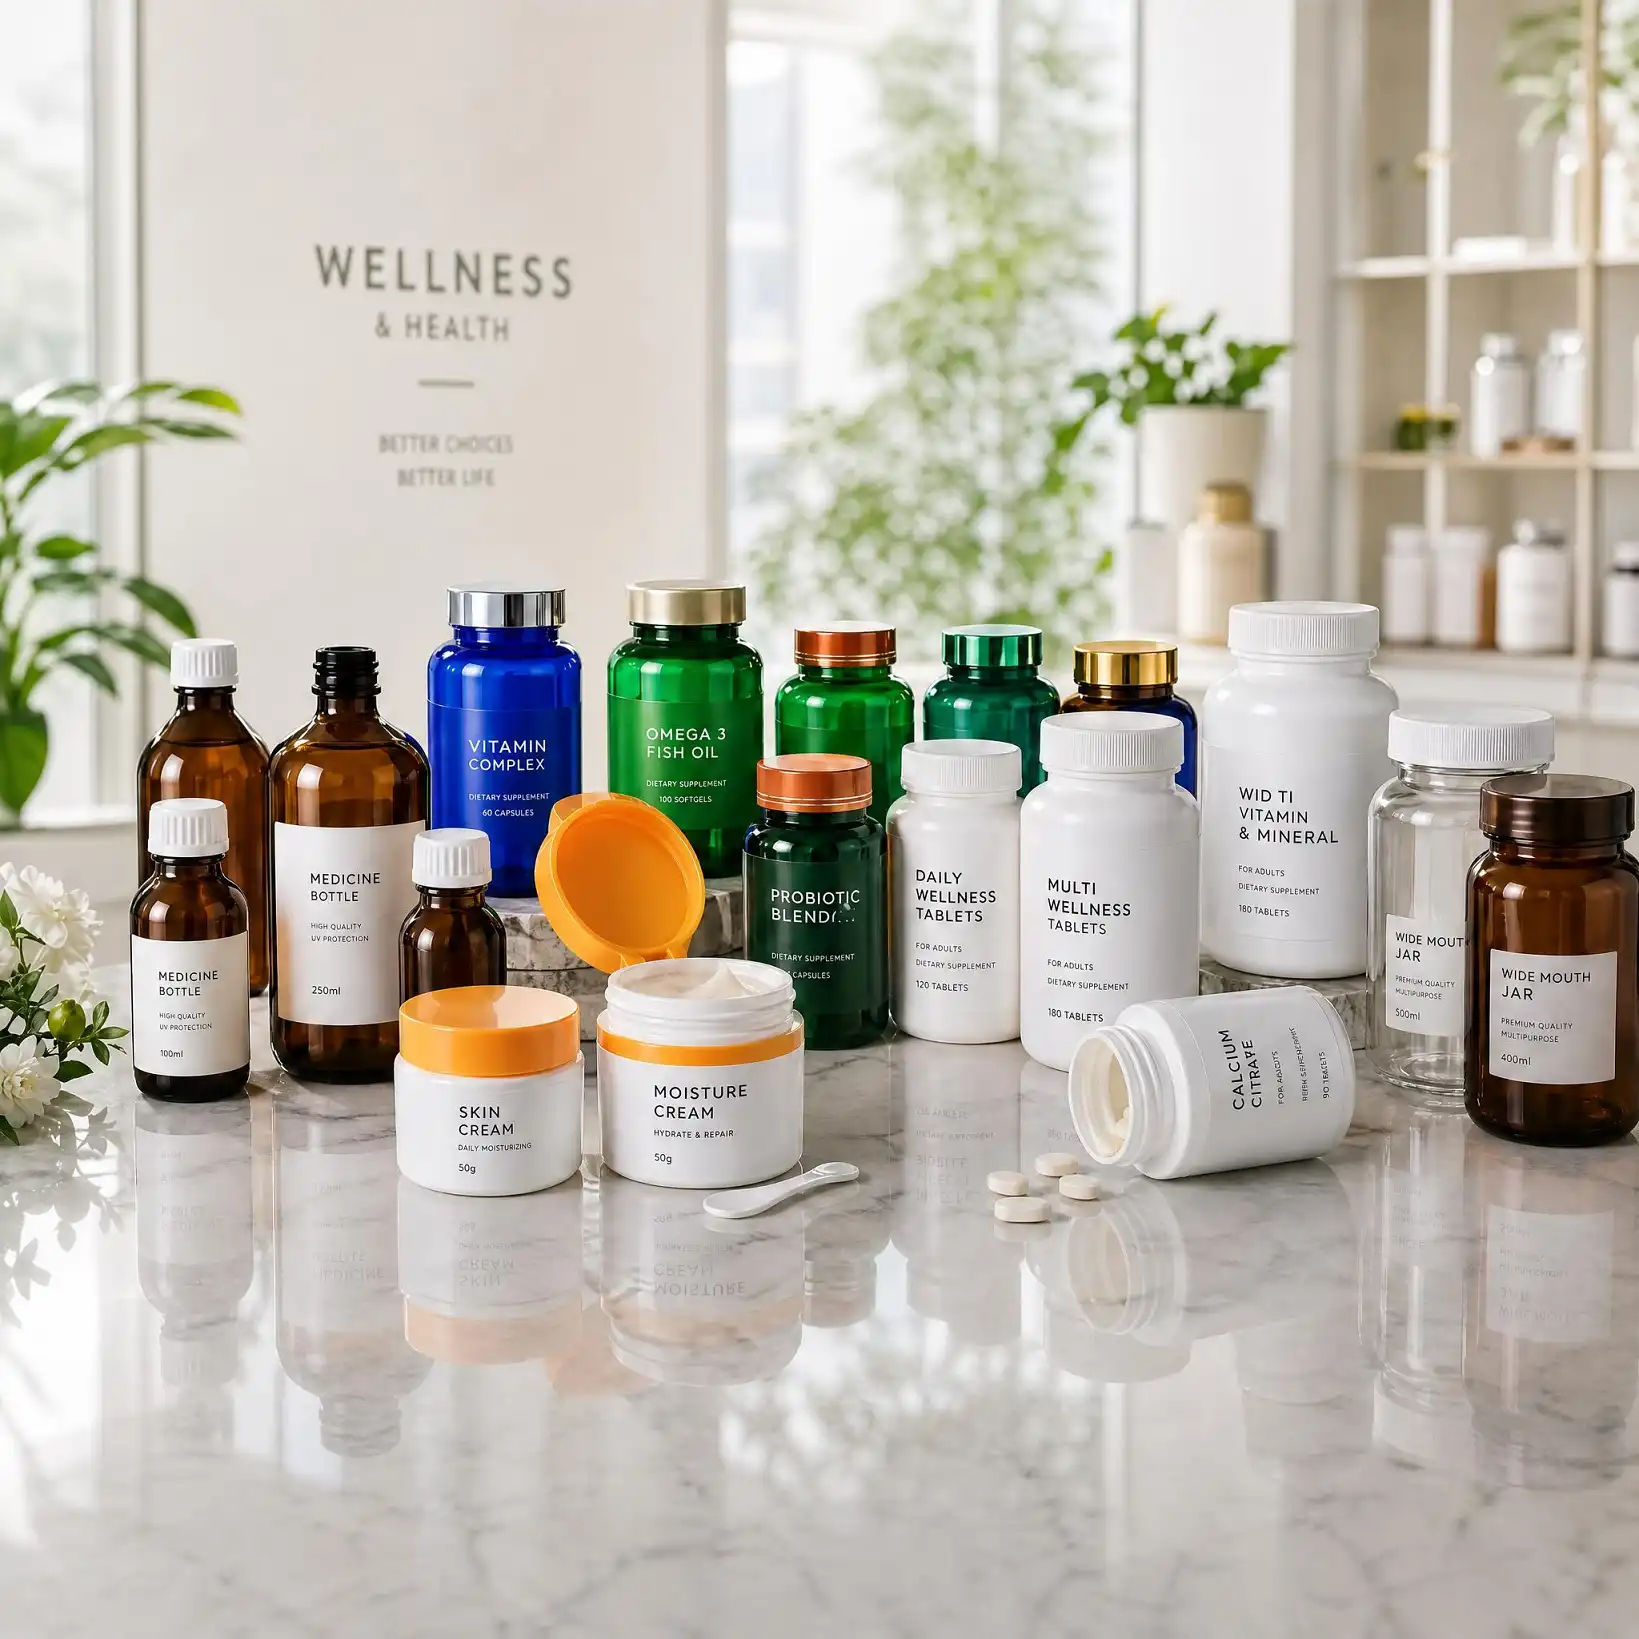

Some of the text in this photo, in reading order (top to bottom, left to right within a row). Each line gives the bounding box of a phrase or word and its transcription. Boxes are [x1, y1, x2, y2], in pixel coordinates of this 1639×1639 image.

[314, 244, 573, 299] WELLNESS
[374, 311, 510, 342] & HEALTH
[378, 433, 514, 454] BETTER CHOICES
[396, 467, 495, 487] BETTER LIFE
[646, 727, 726, 741] OMEGA 3
[468, 739, 547, 753] VITAMIN
[647, 746, 719, 759] FISH OIL
[468, 758, 545, 771] COMPLEX
[646, 779, 727, 788] DIETARY SUPPLEMENT
[468, 792, 550, 801] DIETARY SUPPLEMENT
[659, 795, 712, 803] 100 SOFTGELS
[1239, 786, 1293, 804] WID TI
[482, 808, 534, 817] 60 CAPSULES
[1239, 807, 1308, 824] VITAMIN
[1239, 826, 1339, 844] & MINERAL
[916, 869, 962, 885] DAILY
[1238, 865, 1285, 877] FOR ADULTS
[310, 872, 381, 886] MEDICINE
[1047, 877, 1096, 895] MULTI
[1238, 883, 1320, 896] DIETARY SUPPLEMENT
[310, 891, 359, 902] BOTTLE
[771, 888, 860, 905] PROBIOTIC
[916, 889, 996, 904] WELLNESS
[1047, 898, 1131, 917] WELLNESS
[1238, 904, 1290, 918] 180 TABLETS
[916, 907, 983, 923] TABLETS
[330, 923, 362, 931] QUALITY
[1047, 918, 1107, 935] TABLETS
[322, 935, 369, 943] PROTECTION
[1395, 931, 1422, 945] WIDE
[916, 942, 962, 953] FOR ADULTS
[771, 952, 855, 962] DIETARY SUPPLEMENT
[1395, 948, 1421, 963] JAR
[916, 959, 996, 970] DIETARY SUPPLEMENT
[1047, 959, 1094, 971] FOR ADULTS
[158, 970, 219, 982] MEDICINE
[792, 971, 831, 979] CAPSULES
[1395, 975, 1456, 988] PREMIUM QUALITY
[1501, 968, 1591, 984] WIDE MOUTH
[312, 985, 341, 996] 250ml
[916, 980, 969, 992] 120 TABLETS
[1047, 977, 1129, 991] DIETARY SUPPLEMENT
[159, 986, 201, 997] BOTTLE
[1395, 987, 1442, 1000] MULTIPURPOSE
[1501, 985, 1534, 1001] JAR
[177, 1012, 206, 1020] QUALITY
[1048, 1008, 1104, 1023] 180 TABLETS
[1395, 1007, 1421, 1020] 500ml
[169, 1023, 212, 1031] PROTECTION
[1501, 1017, 1573, 1031] PREMIUM QUALITY
[1501, 1030, 1559, 1043] MULTIPURPOSE
[160, 1049, 184, 1058] 100ml
[1500, 1053, 1531, 1066] 400ml
[1218, 1030, 1245, 1110] CALCIUM
[654, 1084, 748, 1100] MOISTURE
[459, 1106, 500, 1119] SKIN
[654, 1104, 714, 1120] CREAM
[458, 1123, 514, 1136] CREAM
[653, 1129, 734, 1139] HYDRATE & REPAIR
[458, 1142, 532, 1152] DAILY MOISTURIZING
[654, 1153, 672, 1165] 50g
[458, 1163, 476, 1175] 50g
